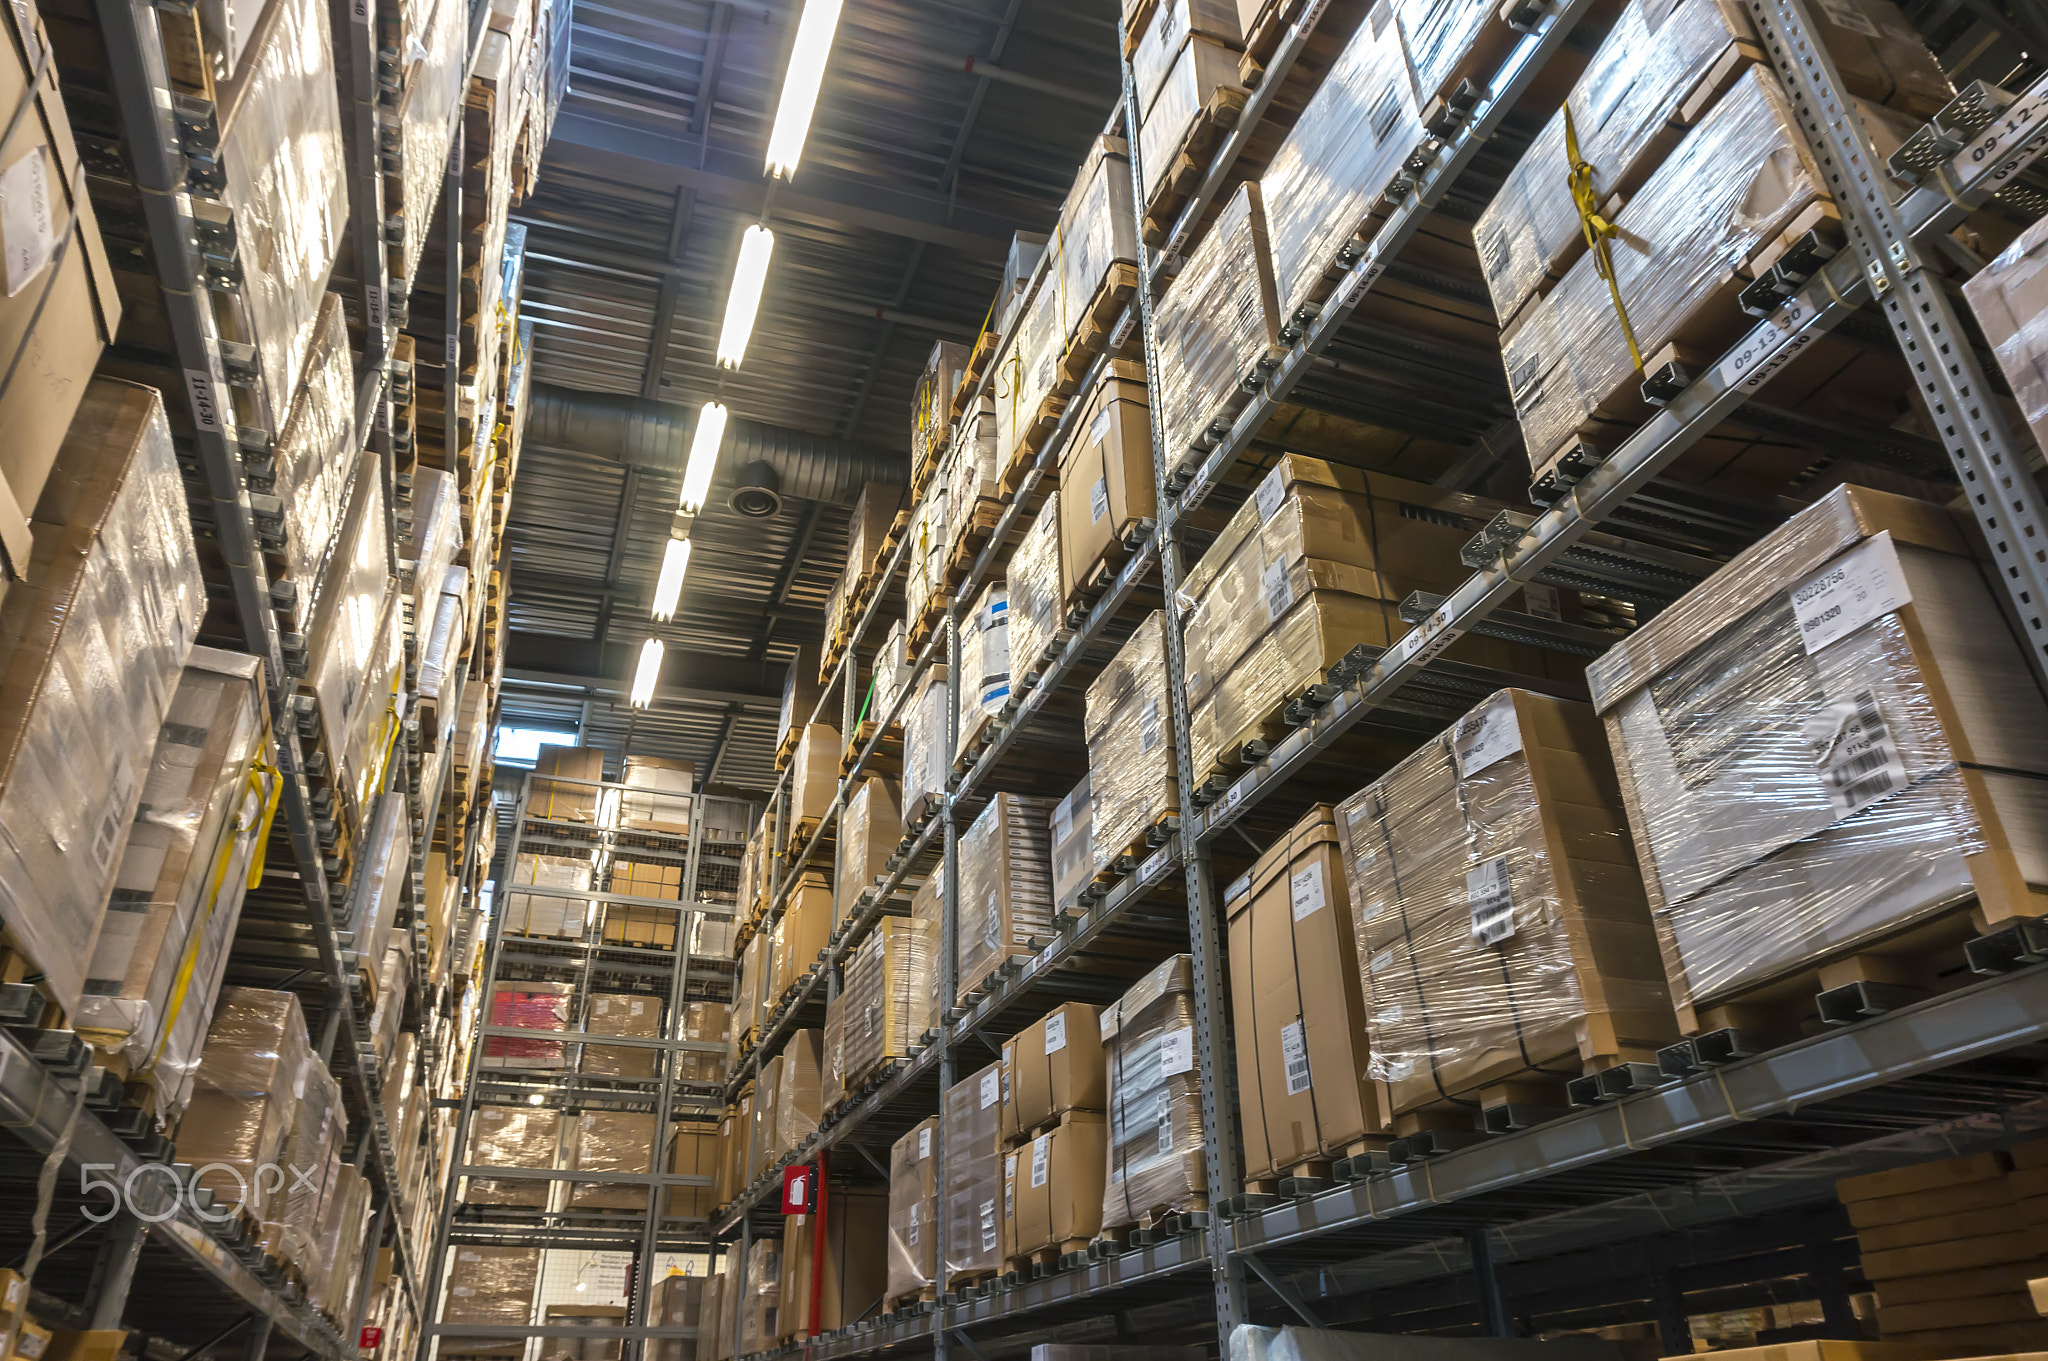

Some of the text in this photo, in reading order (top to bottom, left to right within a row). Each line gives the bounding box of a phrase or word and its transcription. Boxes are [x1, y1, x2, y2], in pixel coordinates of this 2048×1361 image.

[1349, 269, 1378, 302] 09-14-40
[1734, 307, 1801, 370] 09-13-30
[1747, 335, 1810, 386] 09-13-30
[191, 377, 214, 425] 11-14-30
[1795, 569, 1845, 606] 30228756
[1409, 612, 1446, 649] 09-14-30
[1803, 604, 1842, 632] 0901320
[1418, 633, 1456, 661] 09-14-30
